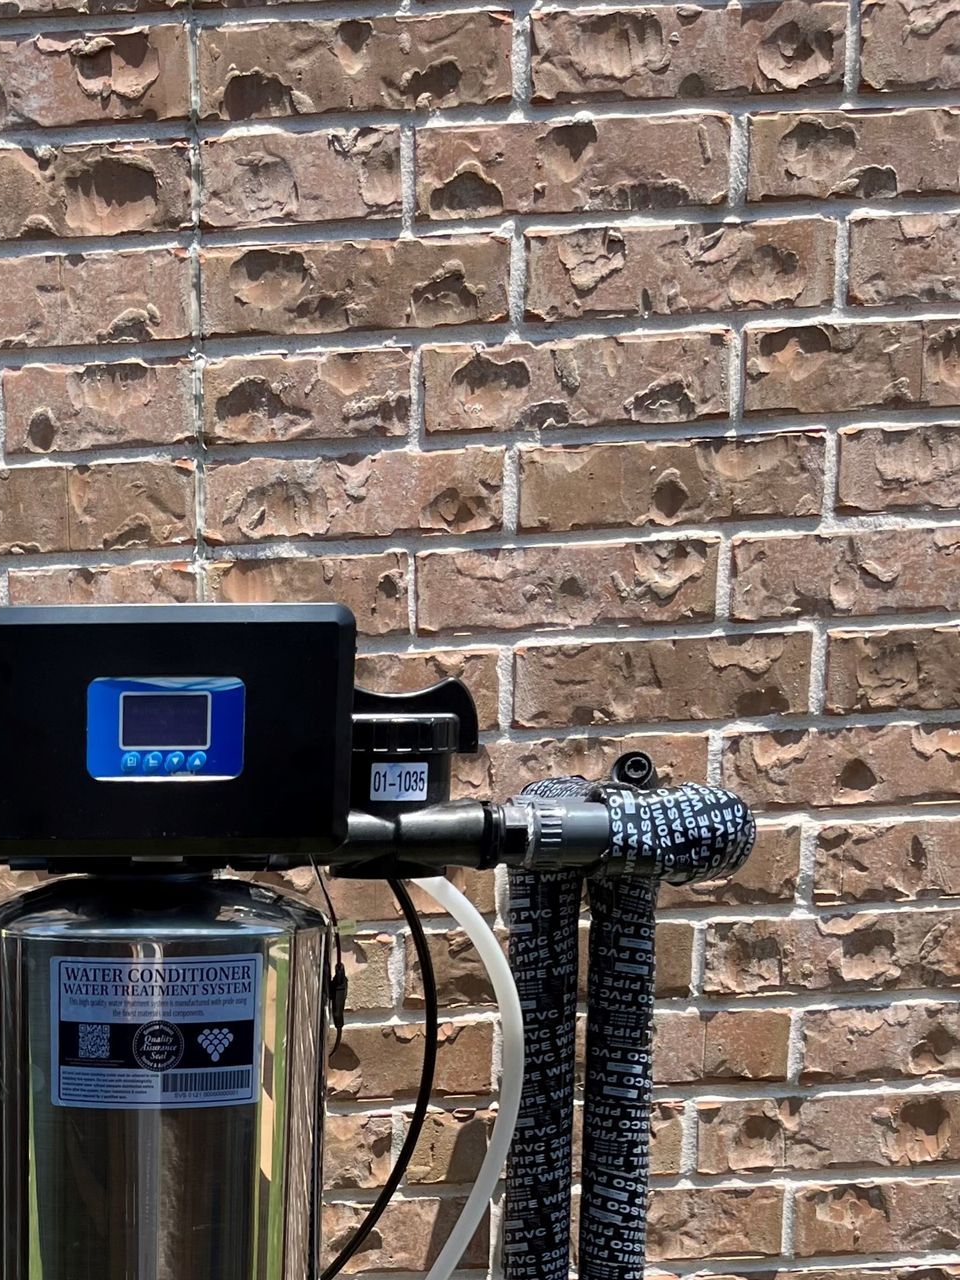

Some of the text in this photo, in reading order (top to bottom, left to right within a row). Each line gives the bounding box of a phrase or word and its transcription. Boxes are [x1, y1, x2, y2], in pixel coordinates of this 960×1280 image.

[373, 770, 426, 793] 01-1035
[657, 788, 685, 844] PASCO
[609, 795, 624, 857] PASCO
[711, 809, 725, 849] PVC
[697, 814, 712, 857] PIPE
[623, 822, 638, 873] WRAP
[521, 909, 552, 920] PVC
[602, 922, 634, 934] PVC
[518, 936, 548, 950] PVC
[516, 948, 550, 965] PIPE
[599, 947, 629, 959] PVC
[64, 965, 252, 984] WATER CONDITIONER
[513, 969, 546, 980] PIPE
[63, 981, 252, 997] WATER TREATMENT SYSTEM
[604, 977, 640, 989] PIPE
[600, 989, 632, 1001] PVC
[526, 1009, 559, 1021] PVC
[604, 1026, 640, 1038] PIPE
[144, 1035, 174, 1046] Quality
[140, 1043, 178, 1051] Assurance
[592, 1047, 621, 1058] PVC
[150, 1051, 168, 1060] Seal
[590, 1071, 617, 1082] PVC
[525, 1125, 557, 1138] PVC
[515, 1143, 545, 1153] PVC
[512, 1154, 545, 1165] PIPE
[507, 1177, 534, 1186] PIPE
[508, 1200, 538, 1210] PIPE
[516, 1228, 546, 1240] PVC
[509, 1255, 536, 1264] PVC
[507, 1267, 536, 1276] PIPE
